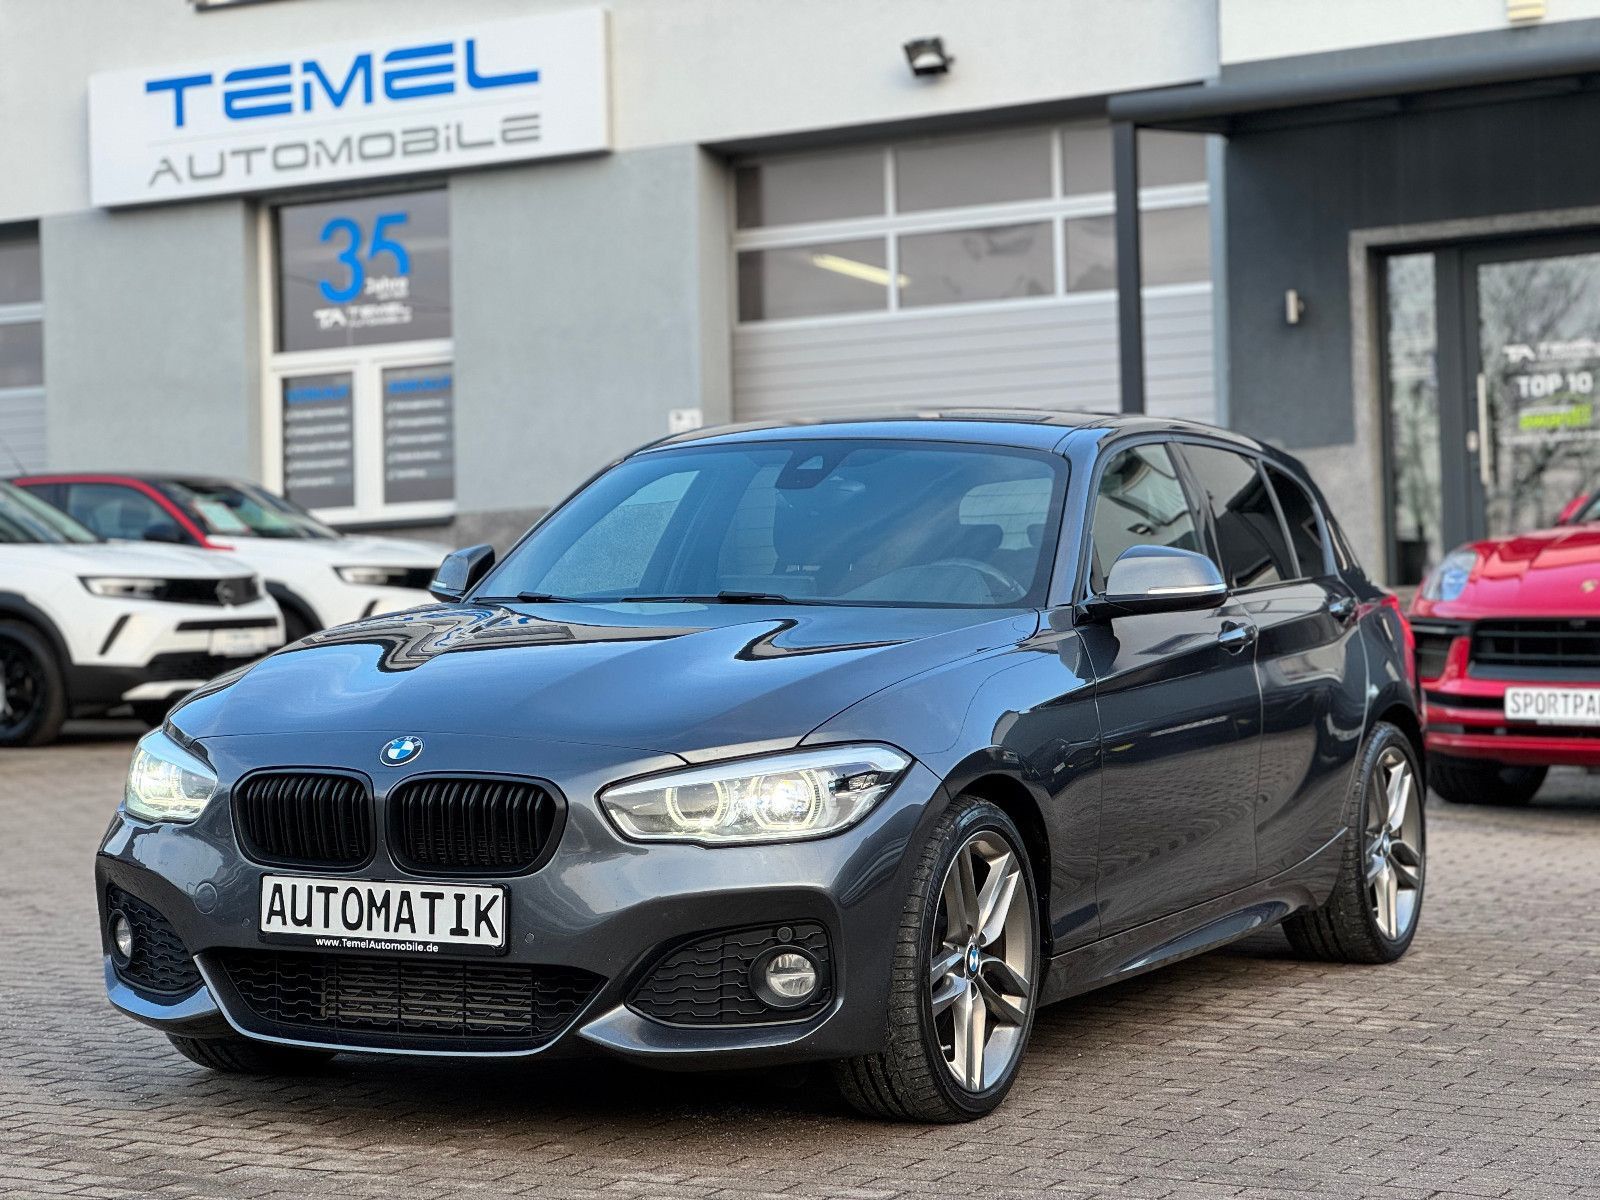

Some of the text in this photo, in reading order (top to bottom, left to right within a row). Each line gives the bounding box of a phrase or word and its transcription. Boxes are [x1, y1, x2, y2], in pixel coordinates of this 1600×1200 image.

[146, 38, 539, 128] TEMEL
[319, 212, 411, 304] 35
[1516, 371, 1593, 398] TOP 10
[1511, 692, 1600, 715] SPORTPA
[266, 883, 499, 938] AUTOMATIK
[315, 937, 439, 953] www.TemelAutomobile.de
